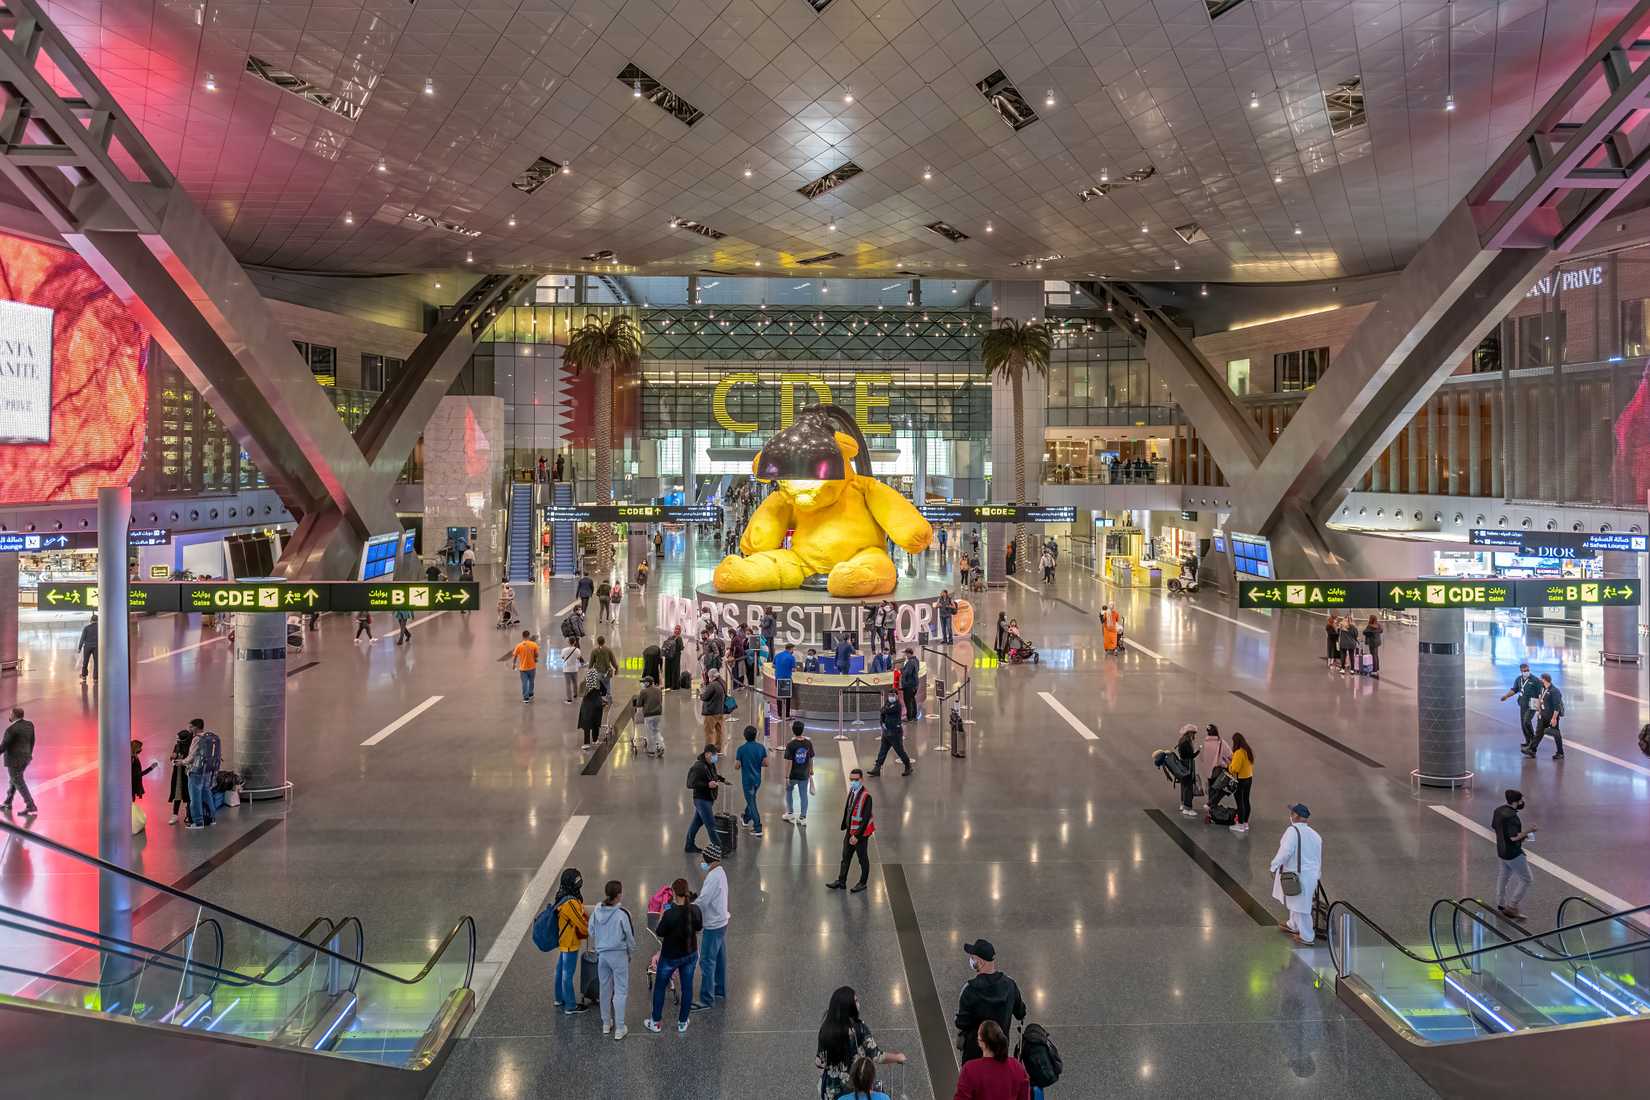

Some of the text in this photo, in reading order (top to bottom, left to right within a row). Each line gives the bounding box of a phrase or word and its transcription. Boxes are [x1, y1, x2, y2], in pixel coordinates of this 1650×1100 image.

[712, 372, 892, 433] CDE
[1538, 547, 1575, 558] DIOR
[214, 590, 254, 606] CDE
[392, 589, 405, 605] B
[1310, 587, 1324, 602] A
[1448, 587, 1486, 602] CDE
[1567, 586, 1577, 600] B
[747, 604, 822, 646] BEST
[831, 602, 946, 644] AIOR
